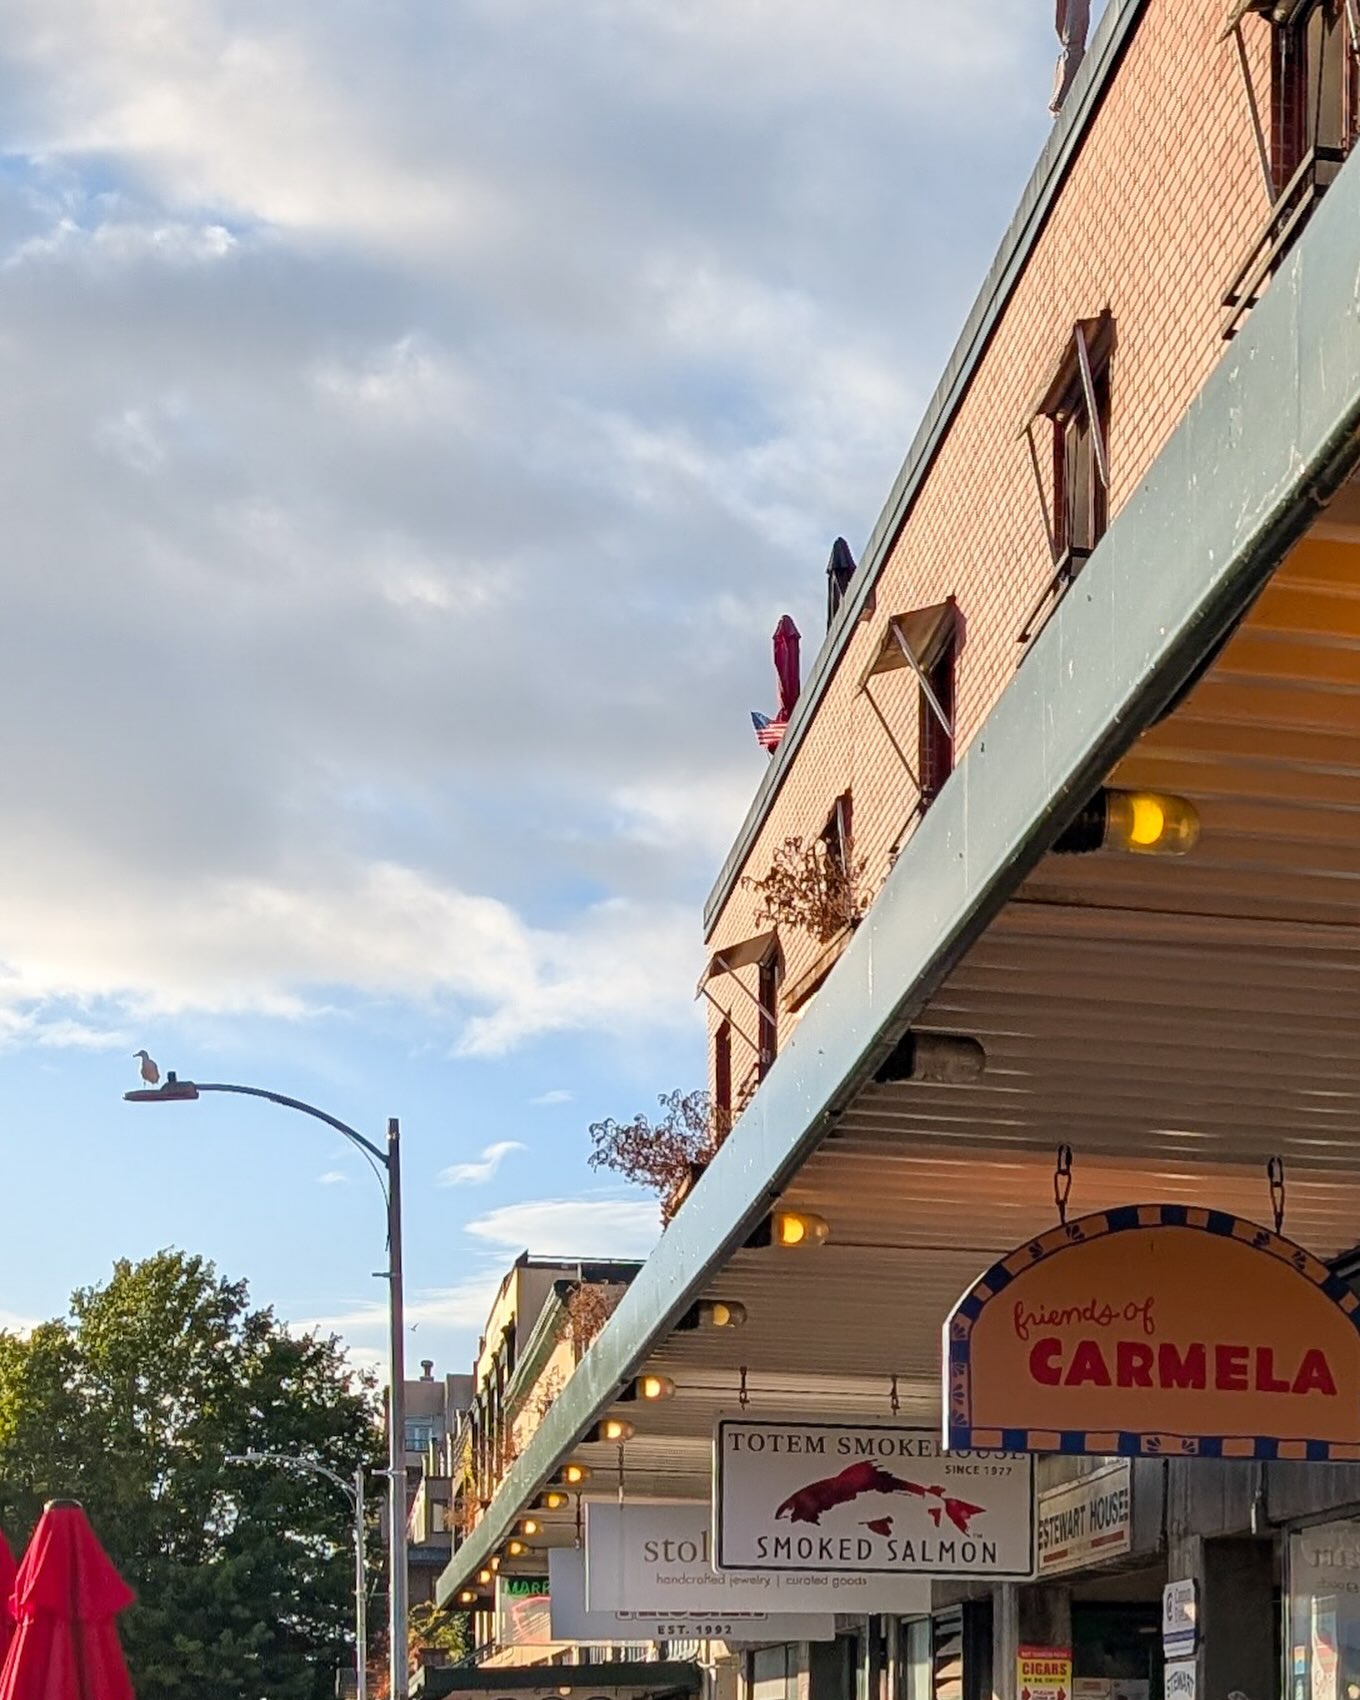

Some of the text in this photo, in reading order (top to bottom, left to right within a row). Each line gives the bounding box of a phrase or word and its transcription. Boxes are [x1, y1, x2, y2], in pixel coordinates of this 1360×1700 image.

[1013, 1296, 1156, 1341] friends of
[1028, 1336, 1339, 1397] CARMELA
[728, 1432, 827, 1455] TOTEM
[945, 1464, 1013, 1476] SINCE 1977
[757, 1535, 997, 1564] SMOKED SALMON
[656, 1574, 867, 1588] handcrafted jewelry curated goods
[657, 1625, 732, 1635] EST. 1992
[1022, 1662, 1067, 1675] CIGARS
